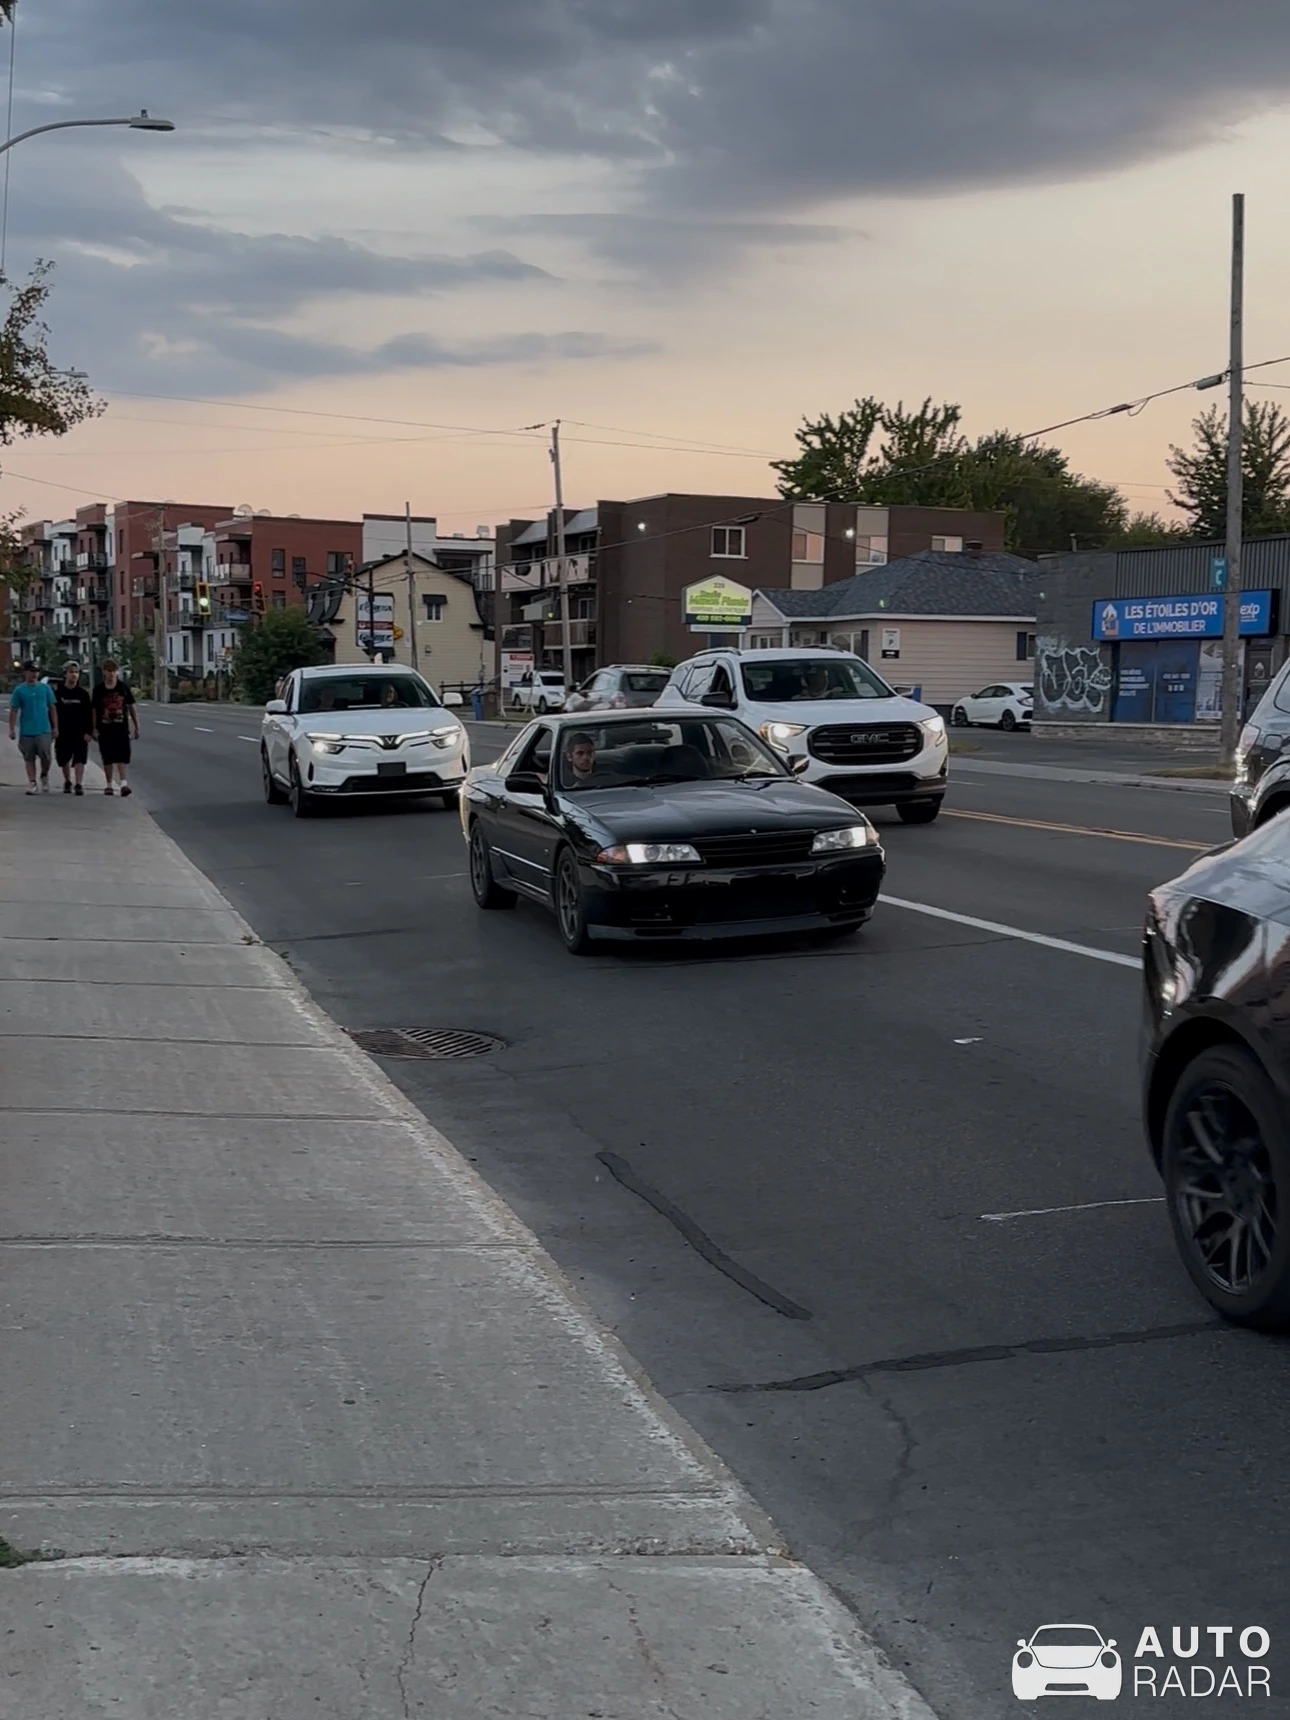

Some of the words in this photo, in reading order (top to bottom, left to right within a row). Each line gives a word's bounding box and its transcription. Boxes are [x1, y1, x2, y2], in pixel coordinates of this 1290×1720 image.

[1124, 605, 1143, 619] LES
[1145, 601, 1188, 618] ÉTOILES
[1190, 601, 1218, 616] D'OR
[1240, 603, 1260, 618] exp
[1133, 622, 1145, 634] DE
[1147, 620, 1206, 634] L'IMMOBILIER
[850, 733, 889, 744] GMC
